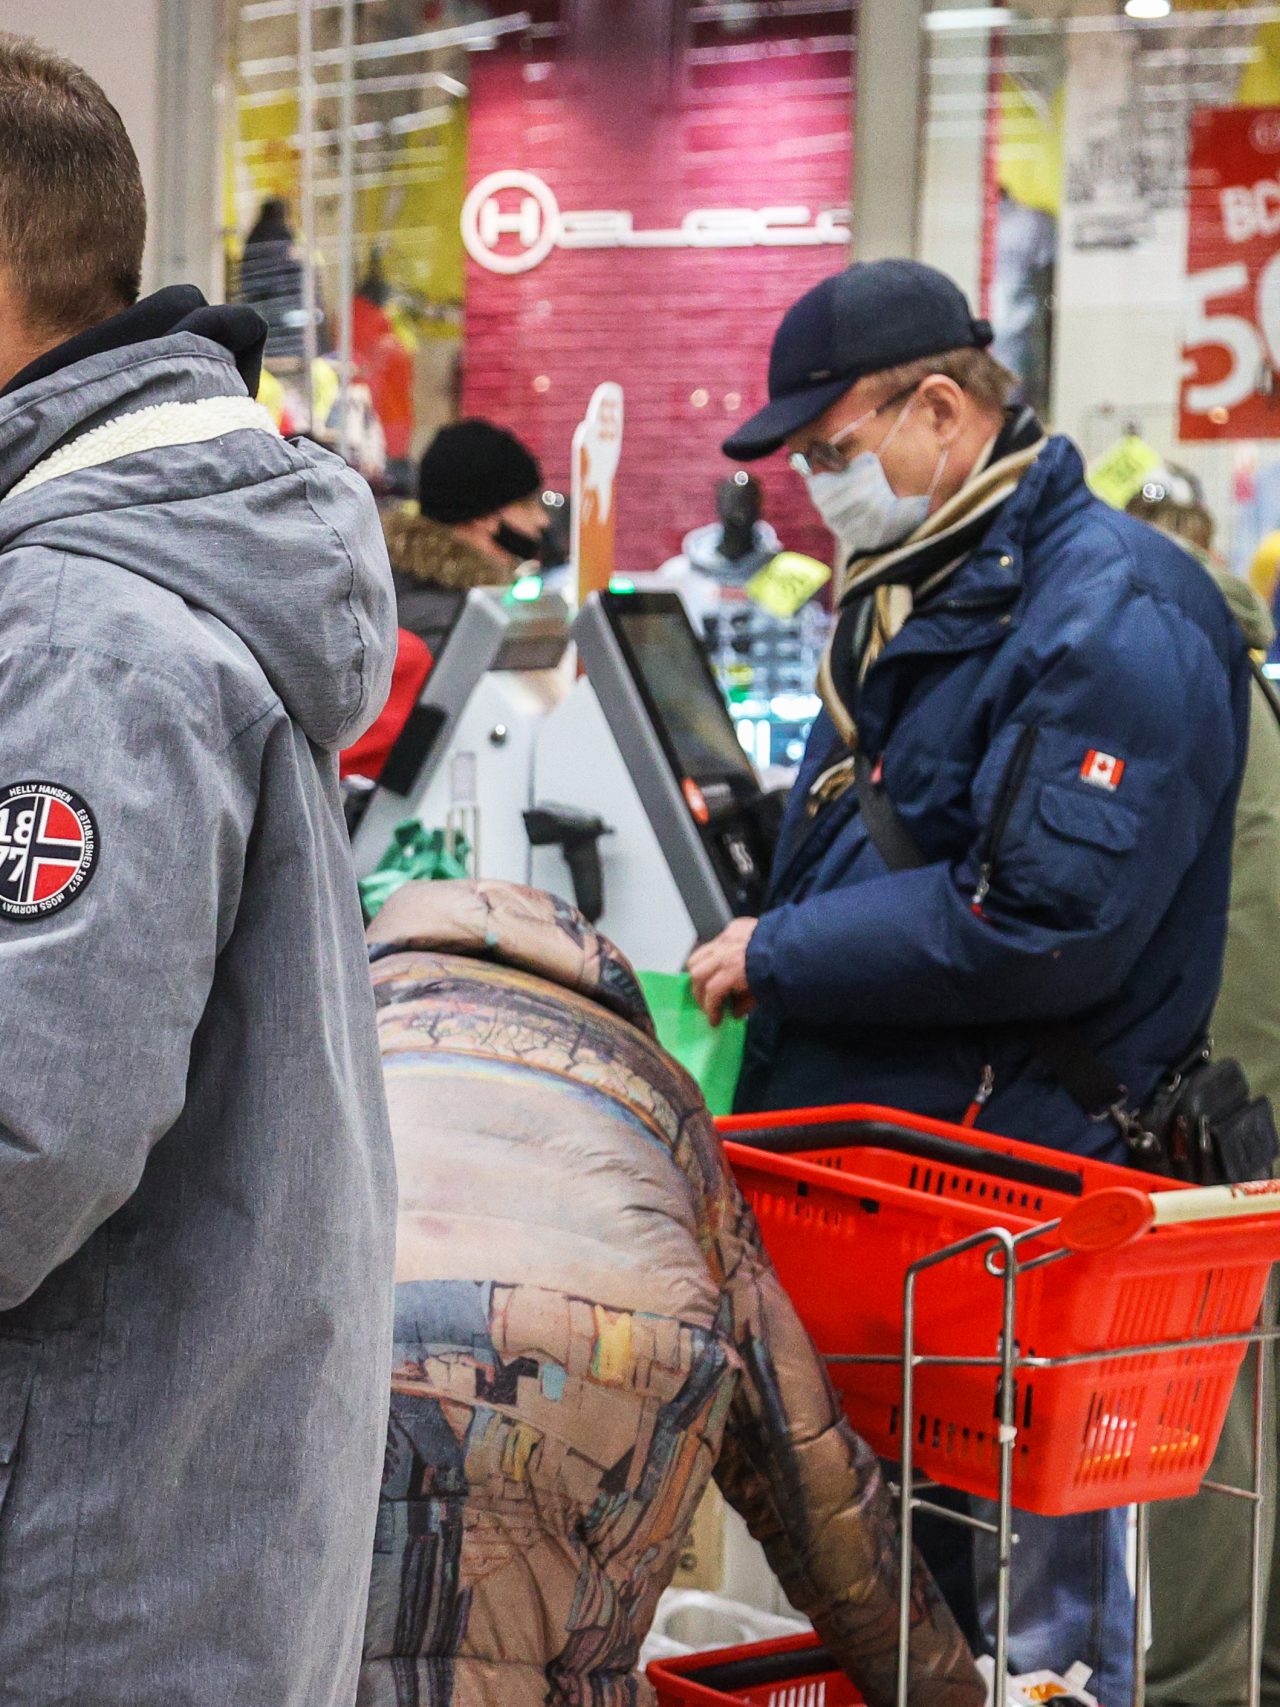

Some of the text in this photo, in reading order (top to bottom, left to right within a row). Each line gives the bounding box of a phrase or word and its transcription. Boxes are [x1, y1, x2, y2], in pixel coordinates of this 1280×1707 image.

[1183, 250, 1280, 412] 5
[9, 785, 73, 803] HELLY HANSEN
[69, 808, 94, 893] ESTABLISHED 1877
[2, 893, 65, 914] MOSS NORWAY
